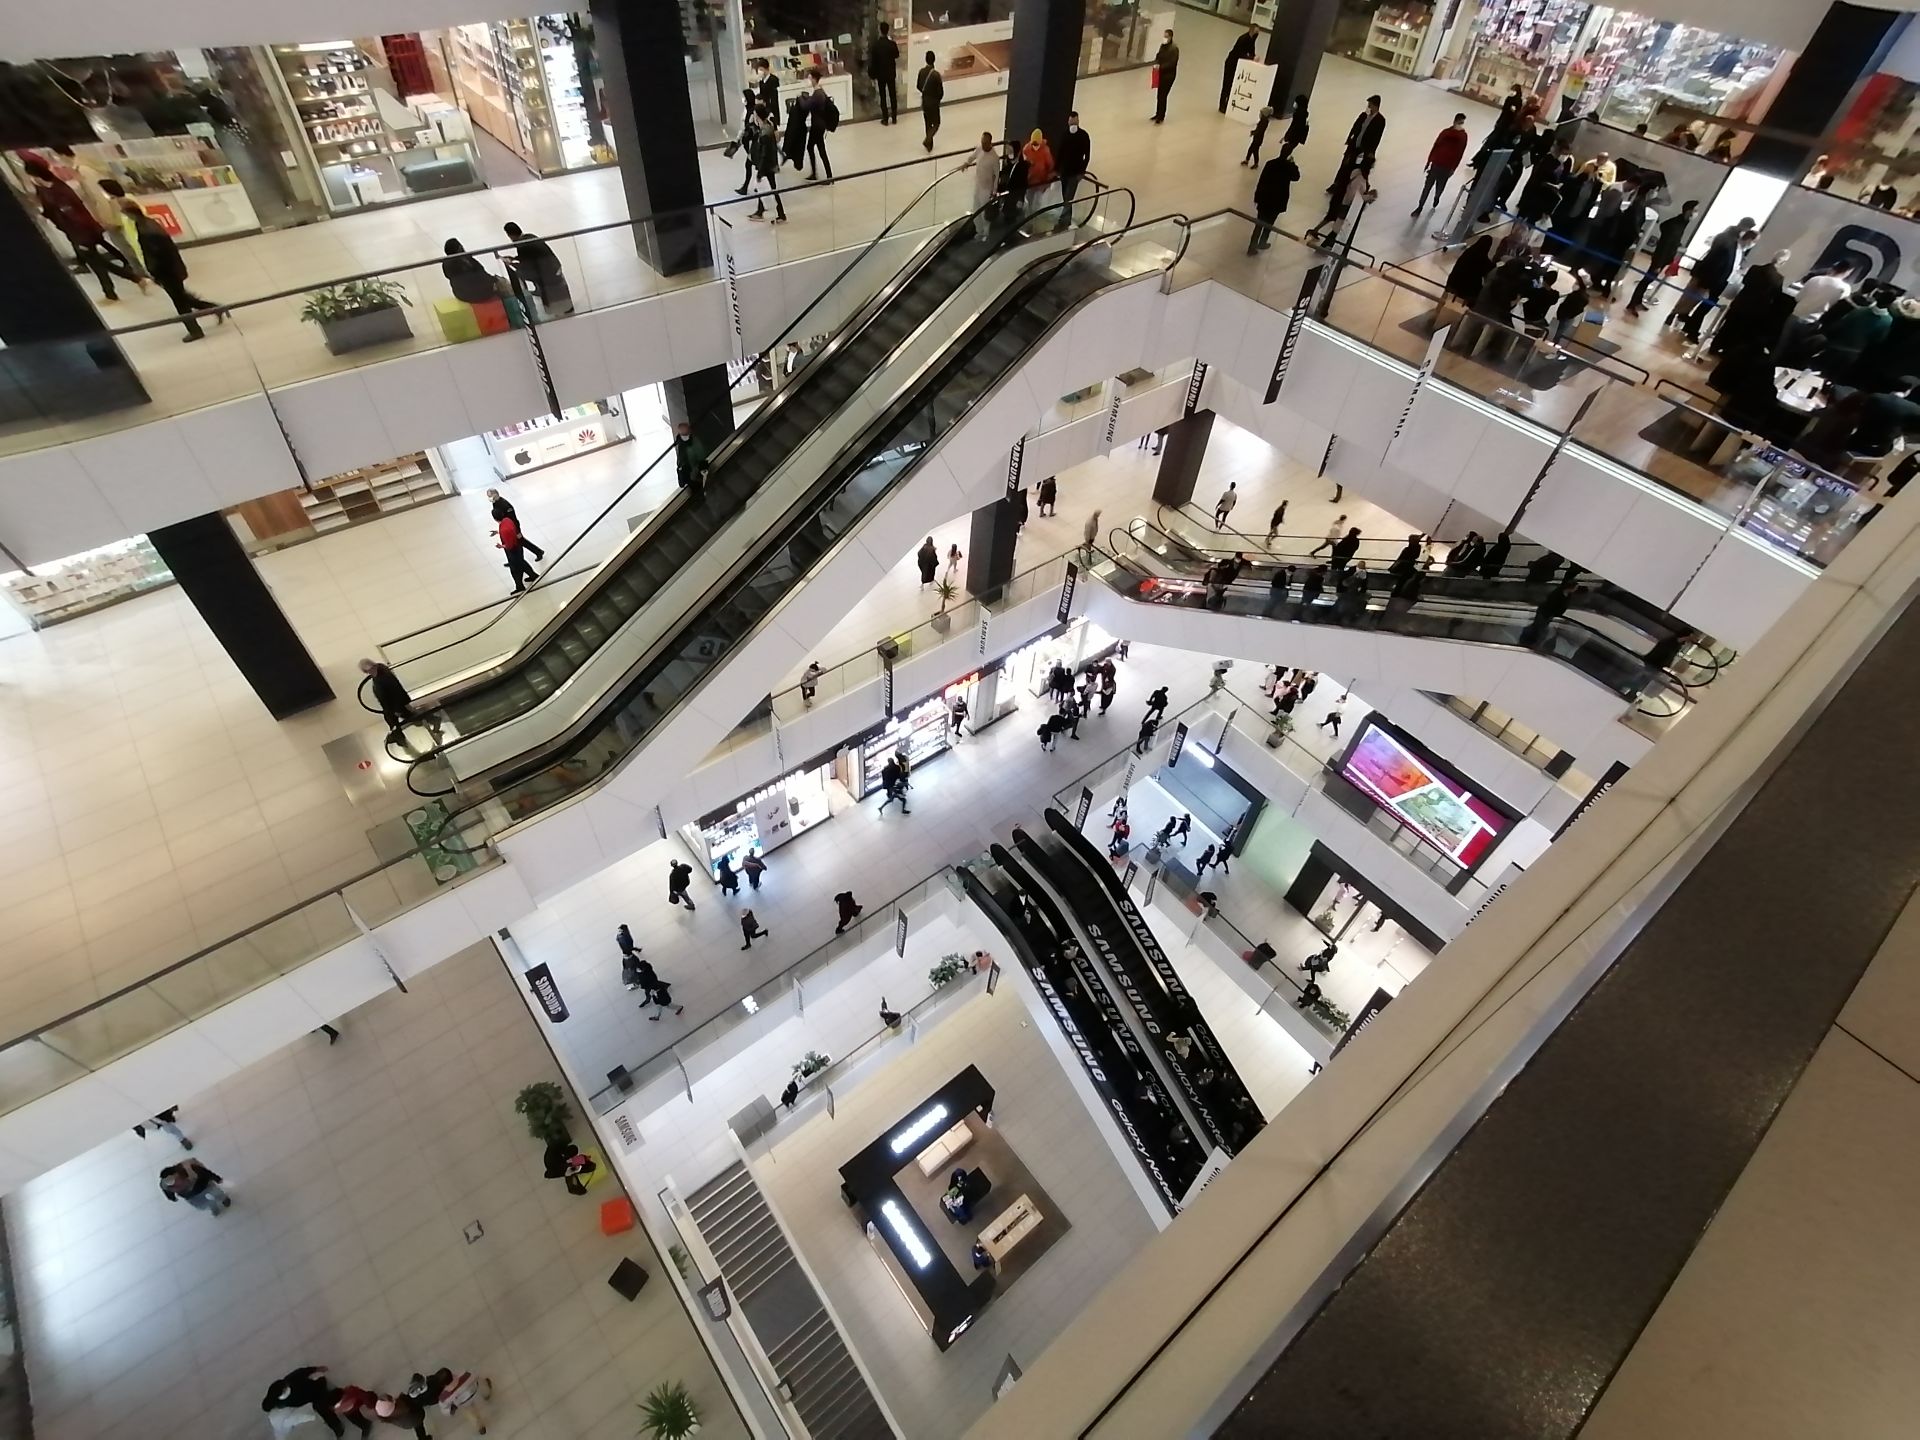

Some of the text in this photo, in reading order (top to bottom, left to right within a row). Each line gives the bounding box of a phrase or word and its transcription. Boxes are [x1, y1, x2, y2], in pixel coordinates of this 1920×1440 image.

[726, 254, 742, 336] SAMSUNG
[1276, 296, 1311, 382] SAMSUNG
[1106, 396, 1121, 443] SAMSUNG
[1060, 574, 1074, 613] SAMSUNG
[980, 620, 989, 655] SAMSUNG
[535, 976, 562, 1015] SAMSUNG
[1076, 957, 1139, 1053] AMSUNG
[1087, 923, 1161, 1034] SAMSUNG
[1031, 967, 1107, 1082] SAMSUNG
[1165, 1049, 1203, 1105] Galaxy
[614, 1115, 638, 1146] SAMSUNG
[1111, 1098, 1150, 1157] Galaxy
